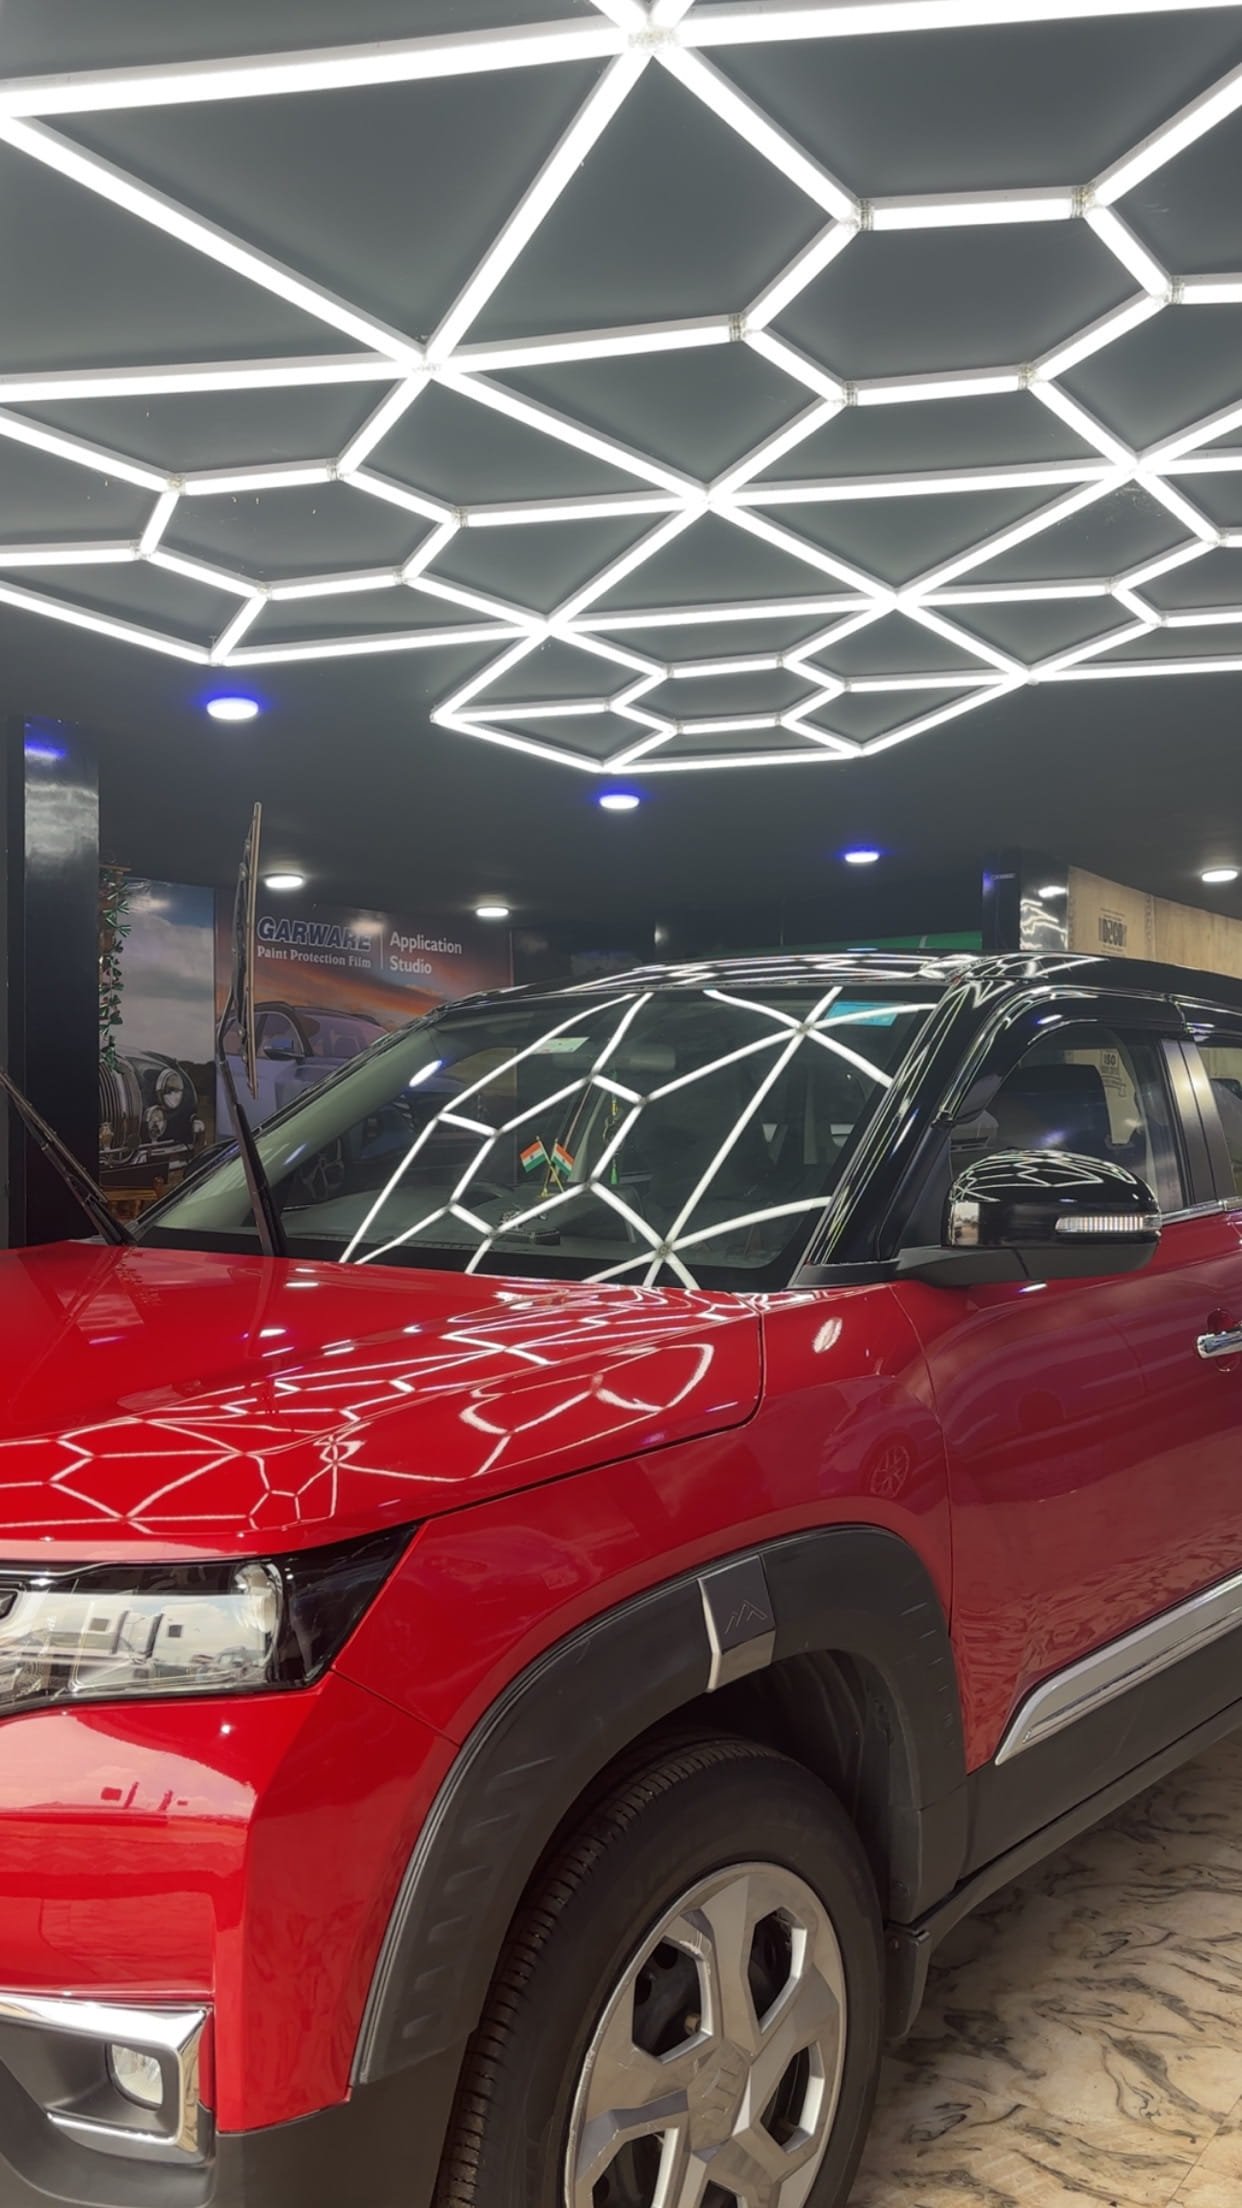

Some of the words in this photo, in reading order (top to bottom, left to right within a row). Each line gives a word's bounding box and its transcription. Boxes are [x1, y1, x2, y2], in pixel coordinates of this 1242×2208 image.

[257, 916, 372, 952] GARWARE
[390, 931, 462, 954] Application
[257, 945, 287, 960] Paint
[290, 949, 346, 966] Protection
[349, 955, 372, 969] Film
[390, 955, 432, 974] Studio
